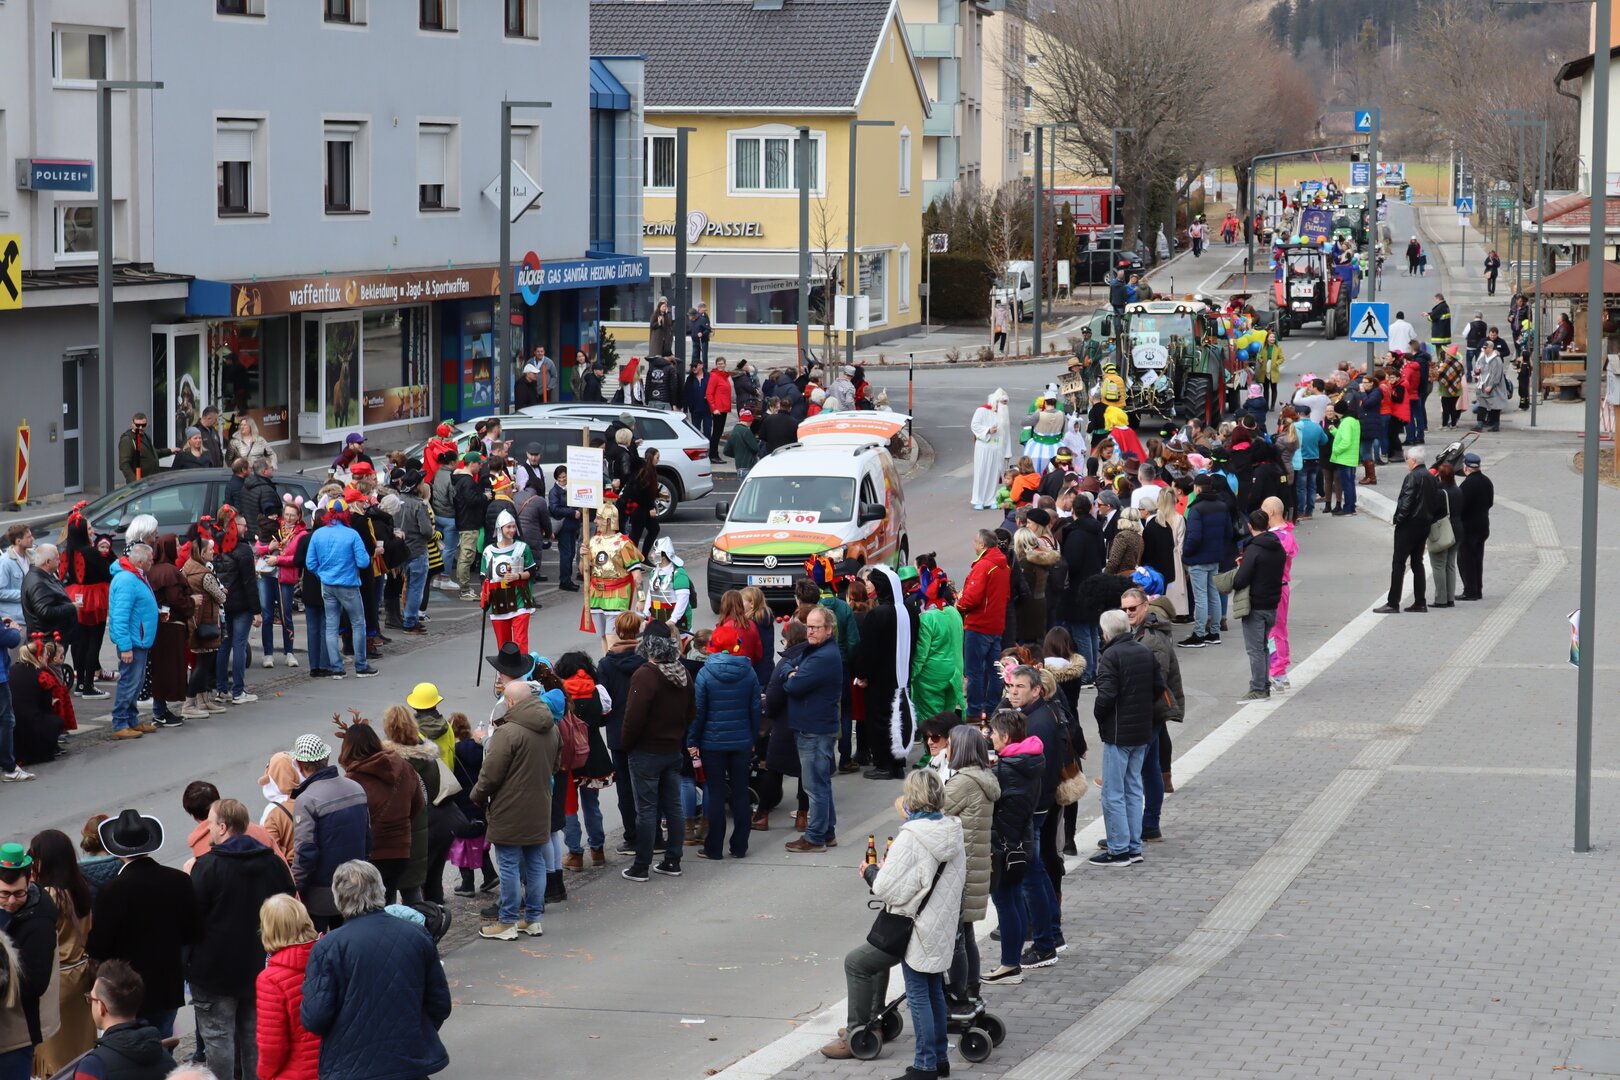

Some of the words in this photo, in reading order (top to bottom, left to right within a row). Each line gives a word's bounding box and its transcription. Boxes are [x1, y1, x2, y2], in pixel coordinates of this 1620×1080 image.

[36, 171, 81, 181] POLIZEI
[643, 224, 677, 236] ECHNI
[705, 222, 764, 237] PASSIEL
[517, 266, 545, 286] RÜCKER
[548, 269, 561, 284] GAS
[563, 264, 589, 282] SANITÄR
[590, 265, 616, 281] HEIZUNG
[617, 261, 643, 278] LÜFTUNG
[753, 282, 785, 291] Premiere
[289, 282, 341, 306] waffenfux
[360, 283, 398, 302] Bekleidung
[406, 281, 424, 300] Jagd-
[425, 280, 431, 295] &
[432, 278, 470, 297] Sportwaffen
[795, 515, 816, 524] 09
[598, 552, 606, 562] a
[499, 565, 507, 574] a
